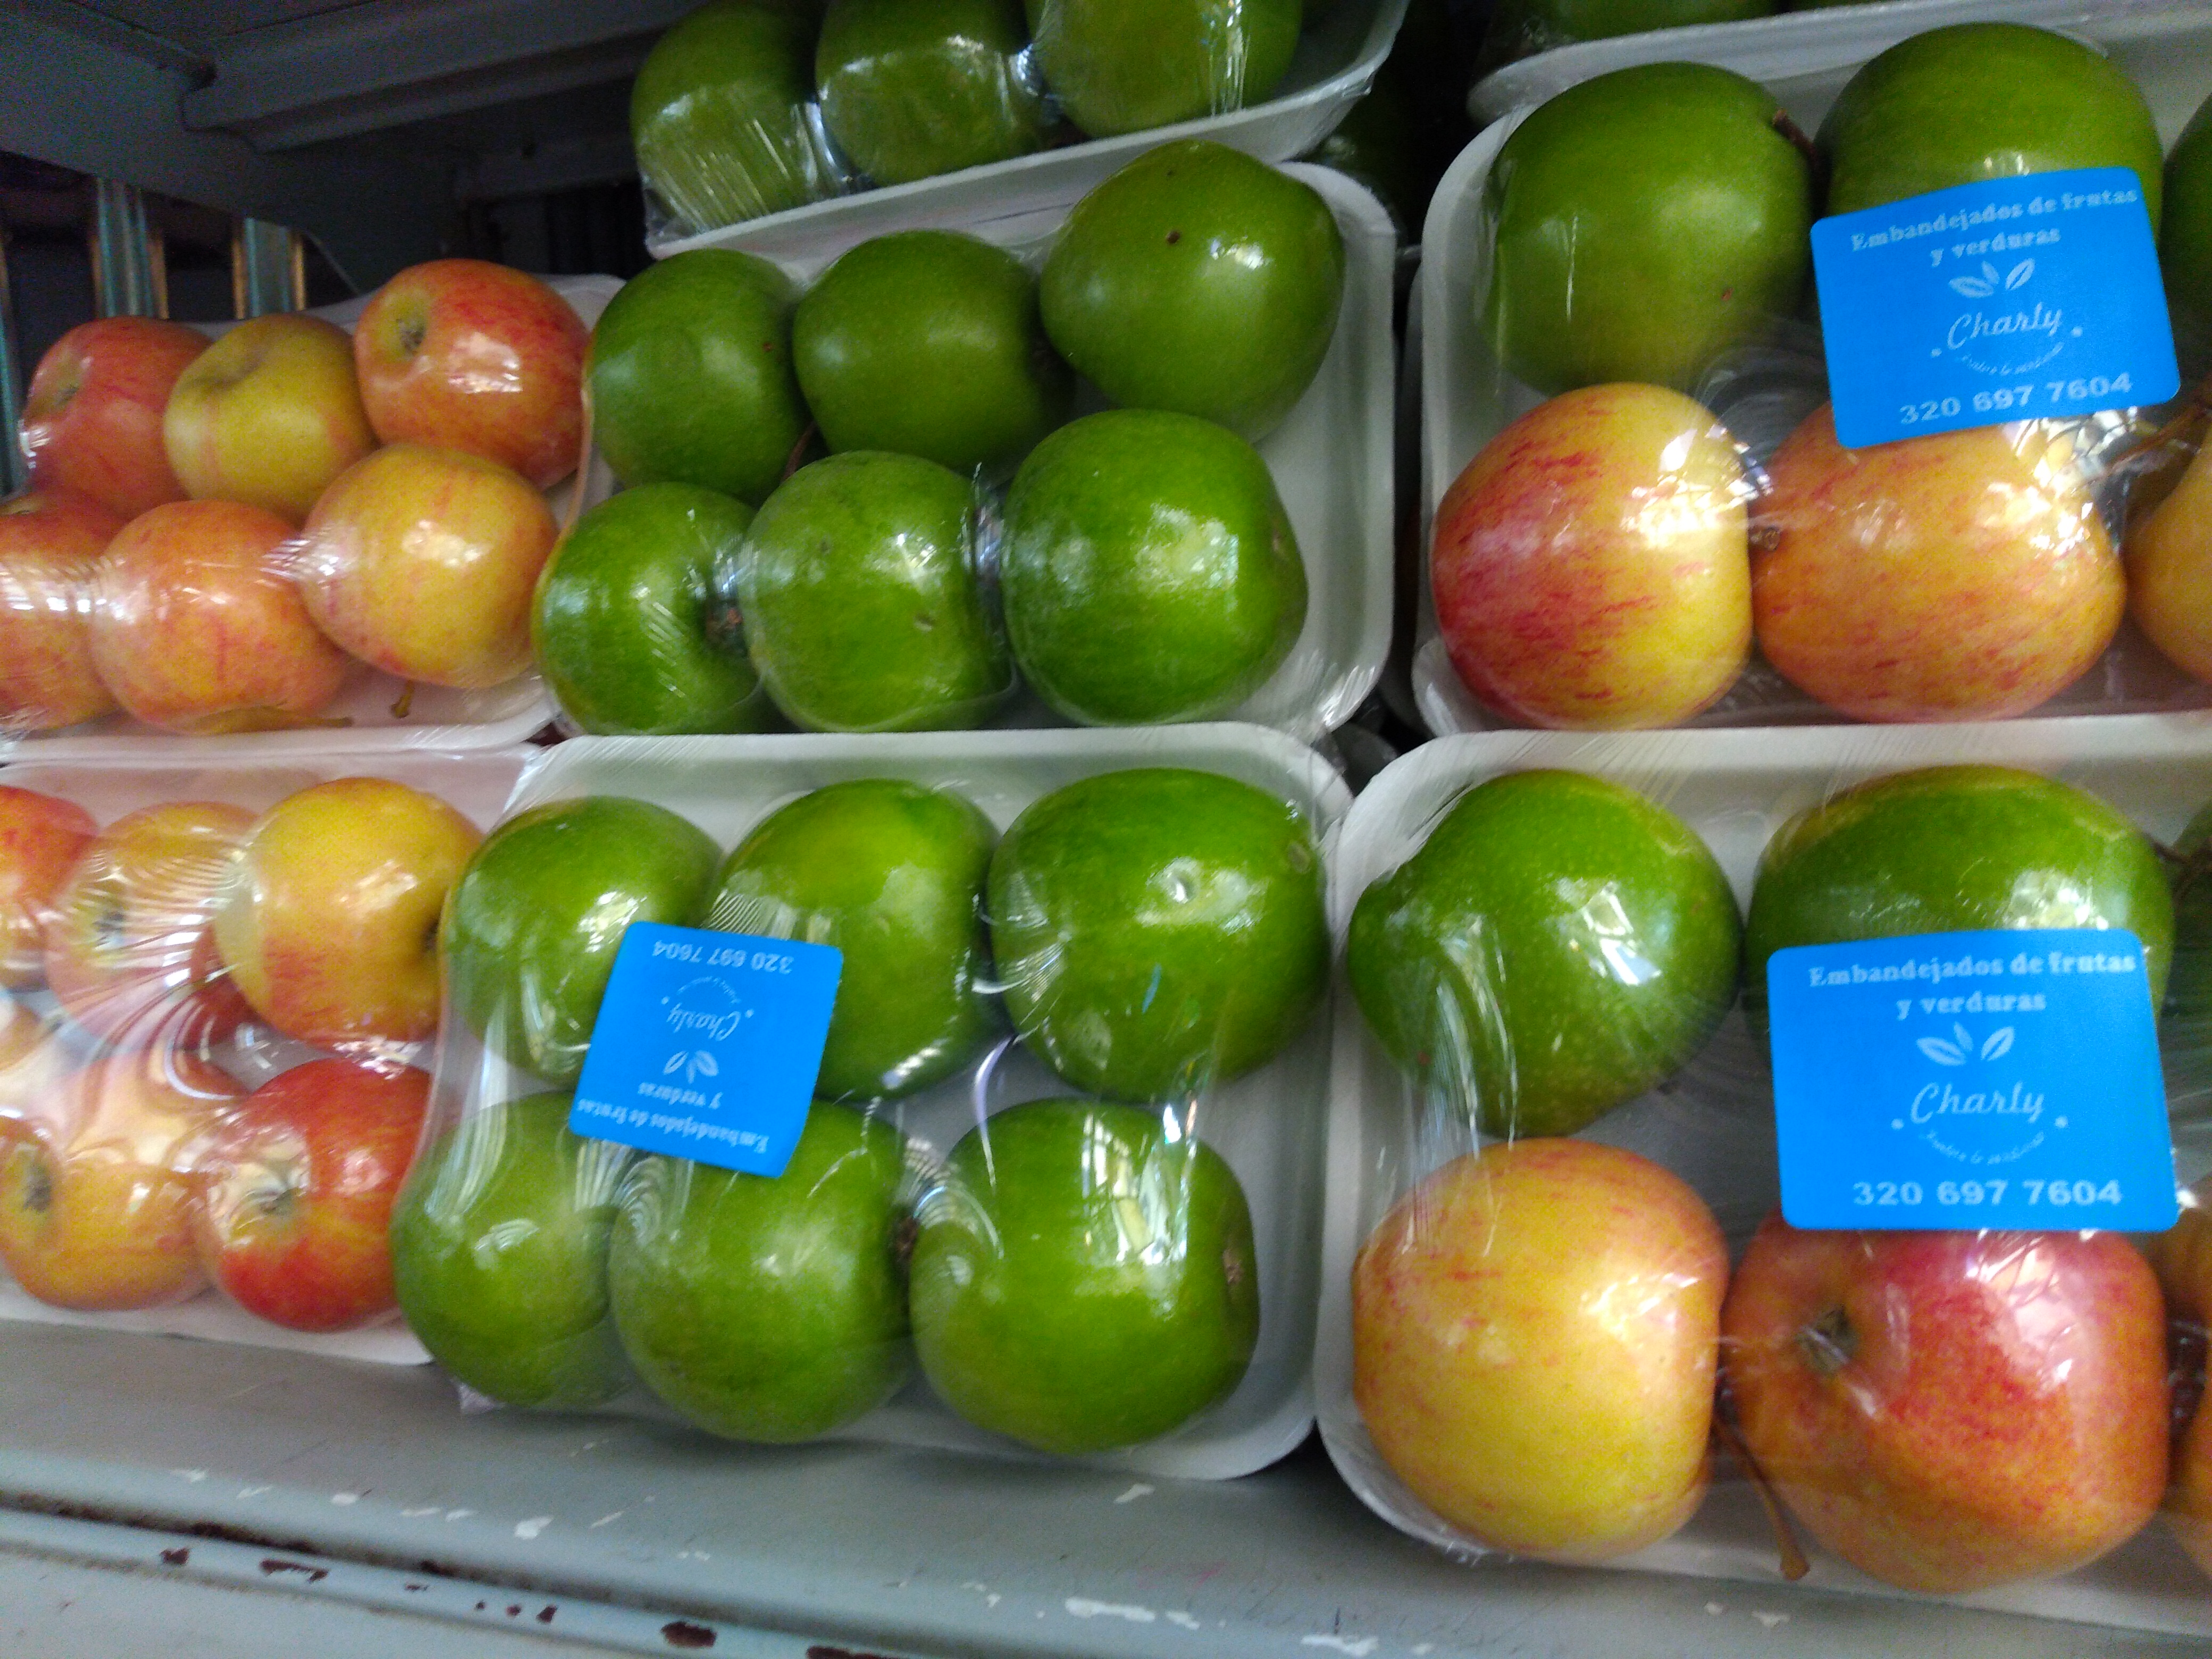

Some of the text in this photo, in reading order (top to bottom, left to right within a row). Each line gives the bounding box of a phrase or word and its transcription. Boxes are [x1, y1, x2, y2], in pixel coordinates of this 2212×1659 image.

[1851, 189, 2138, 252] Embandejados de frutas
[1930, 228, 2061, 267] y verduras
[1947, 301, 2062, 351] Charly
[1899, 372, 2132, 425] 320 697 7604
[652, 940, 794, 975] 320 697 7604
[1809, 951, 2135, 987] Embandejados de frutas
[666, 1002, 741, 1042] Charly
[1896, 990, 2047, 1021] y verduras
[1911, 1082, 2045, 1124] Charly
[1853, 1179, 2123, 1206] 320 697 7604
